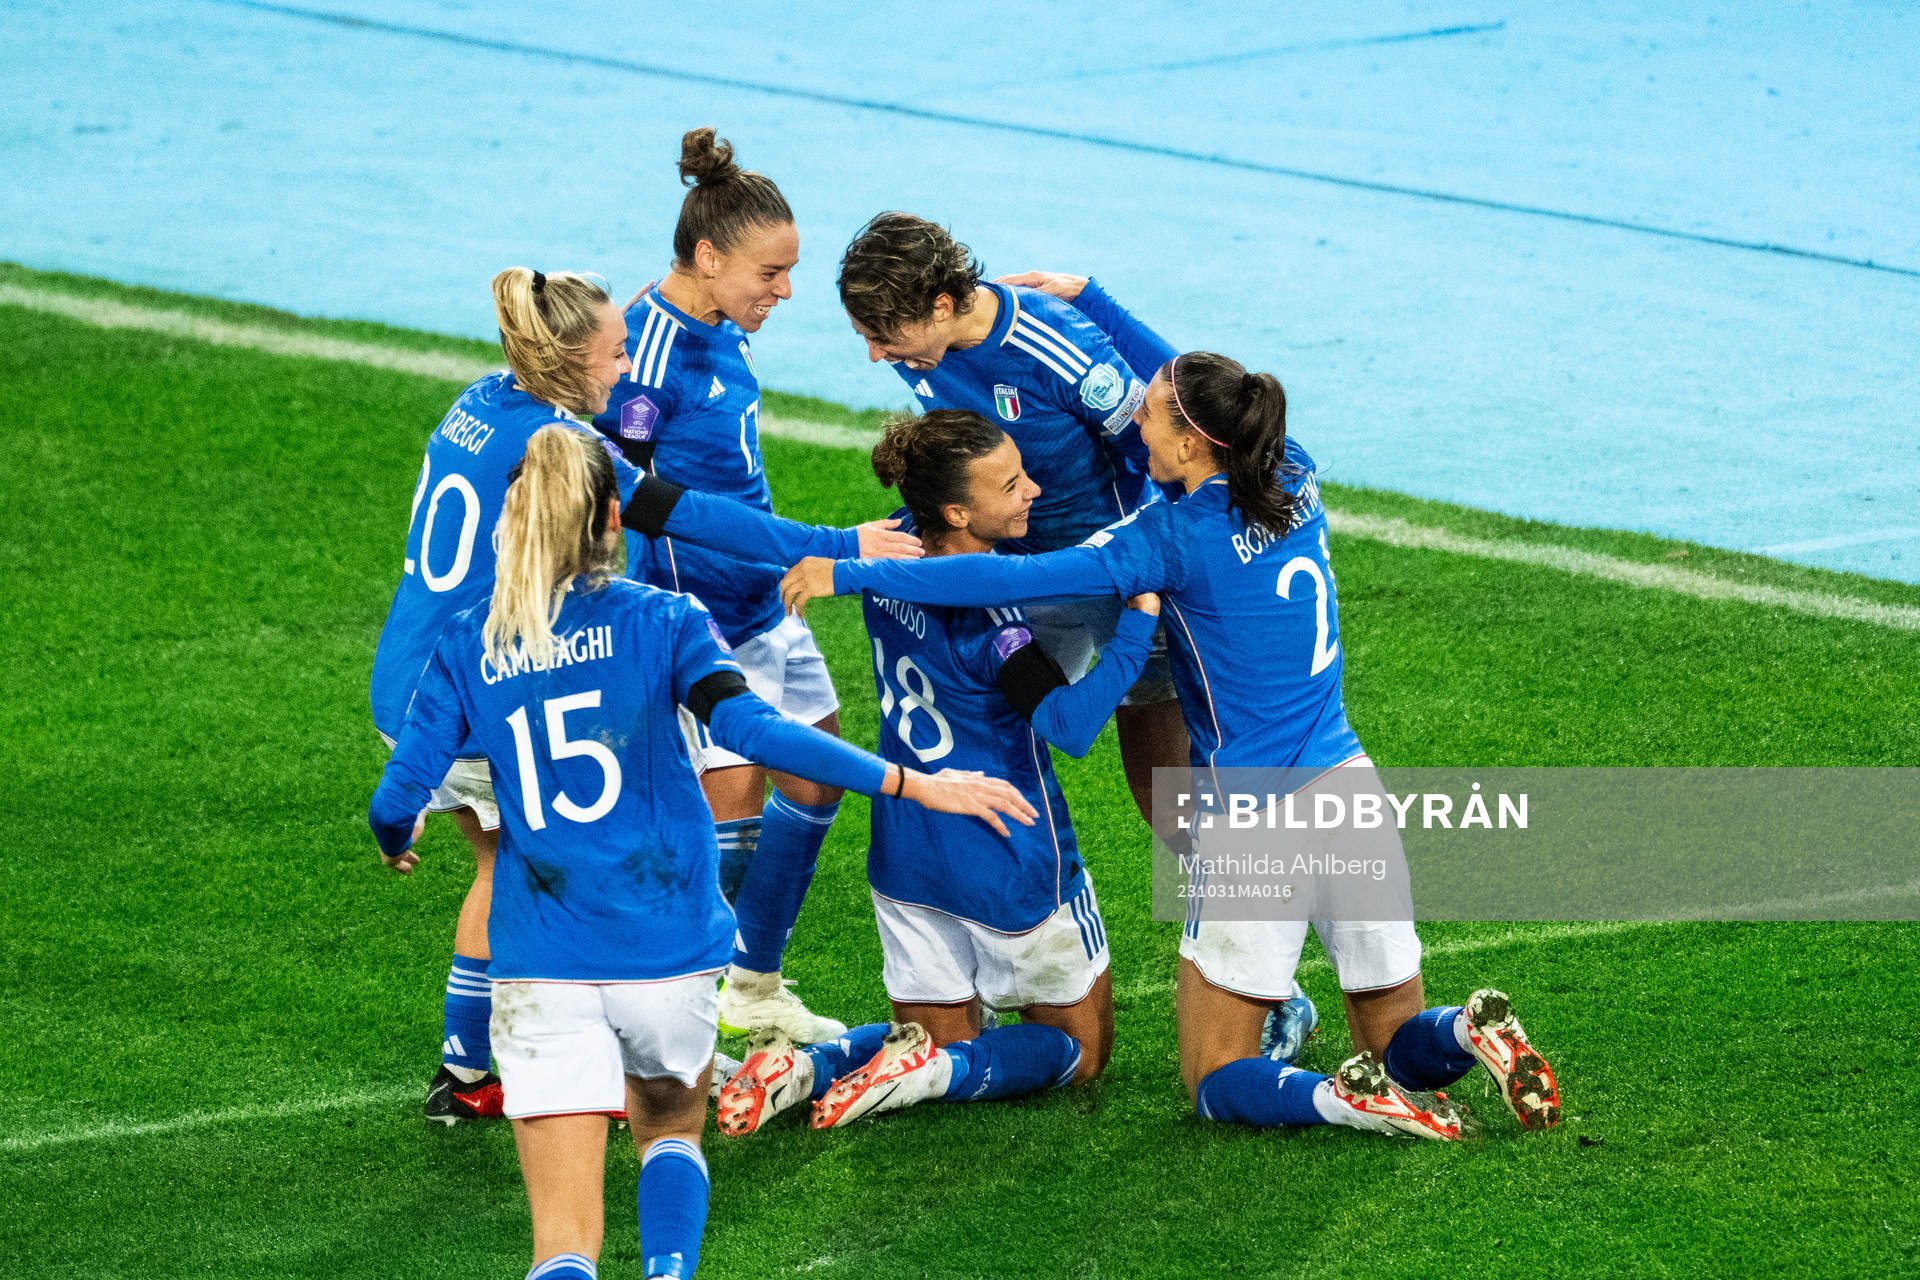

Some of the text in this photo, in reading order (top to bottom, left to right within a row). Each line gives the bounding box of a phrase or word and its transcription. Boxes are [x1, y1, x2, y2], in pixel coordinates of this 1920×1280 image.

[995, 386, 1016, 395] ITALIA
[441, 408, 495, 456] GREGGI
[623, 428, 649, 436] NATIONS
[872, 637, 954, 763] 18
[505, 690, 622, 831] 15
